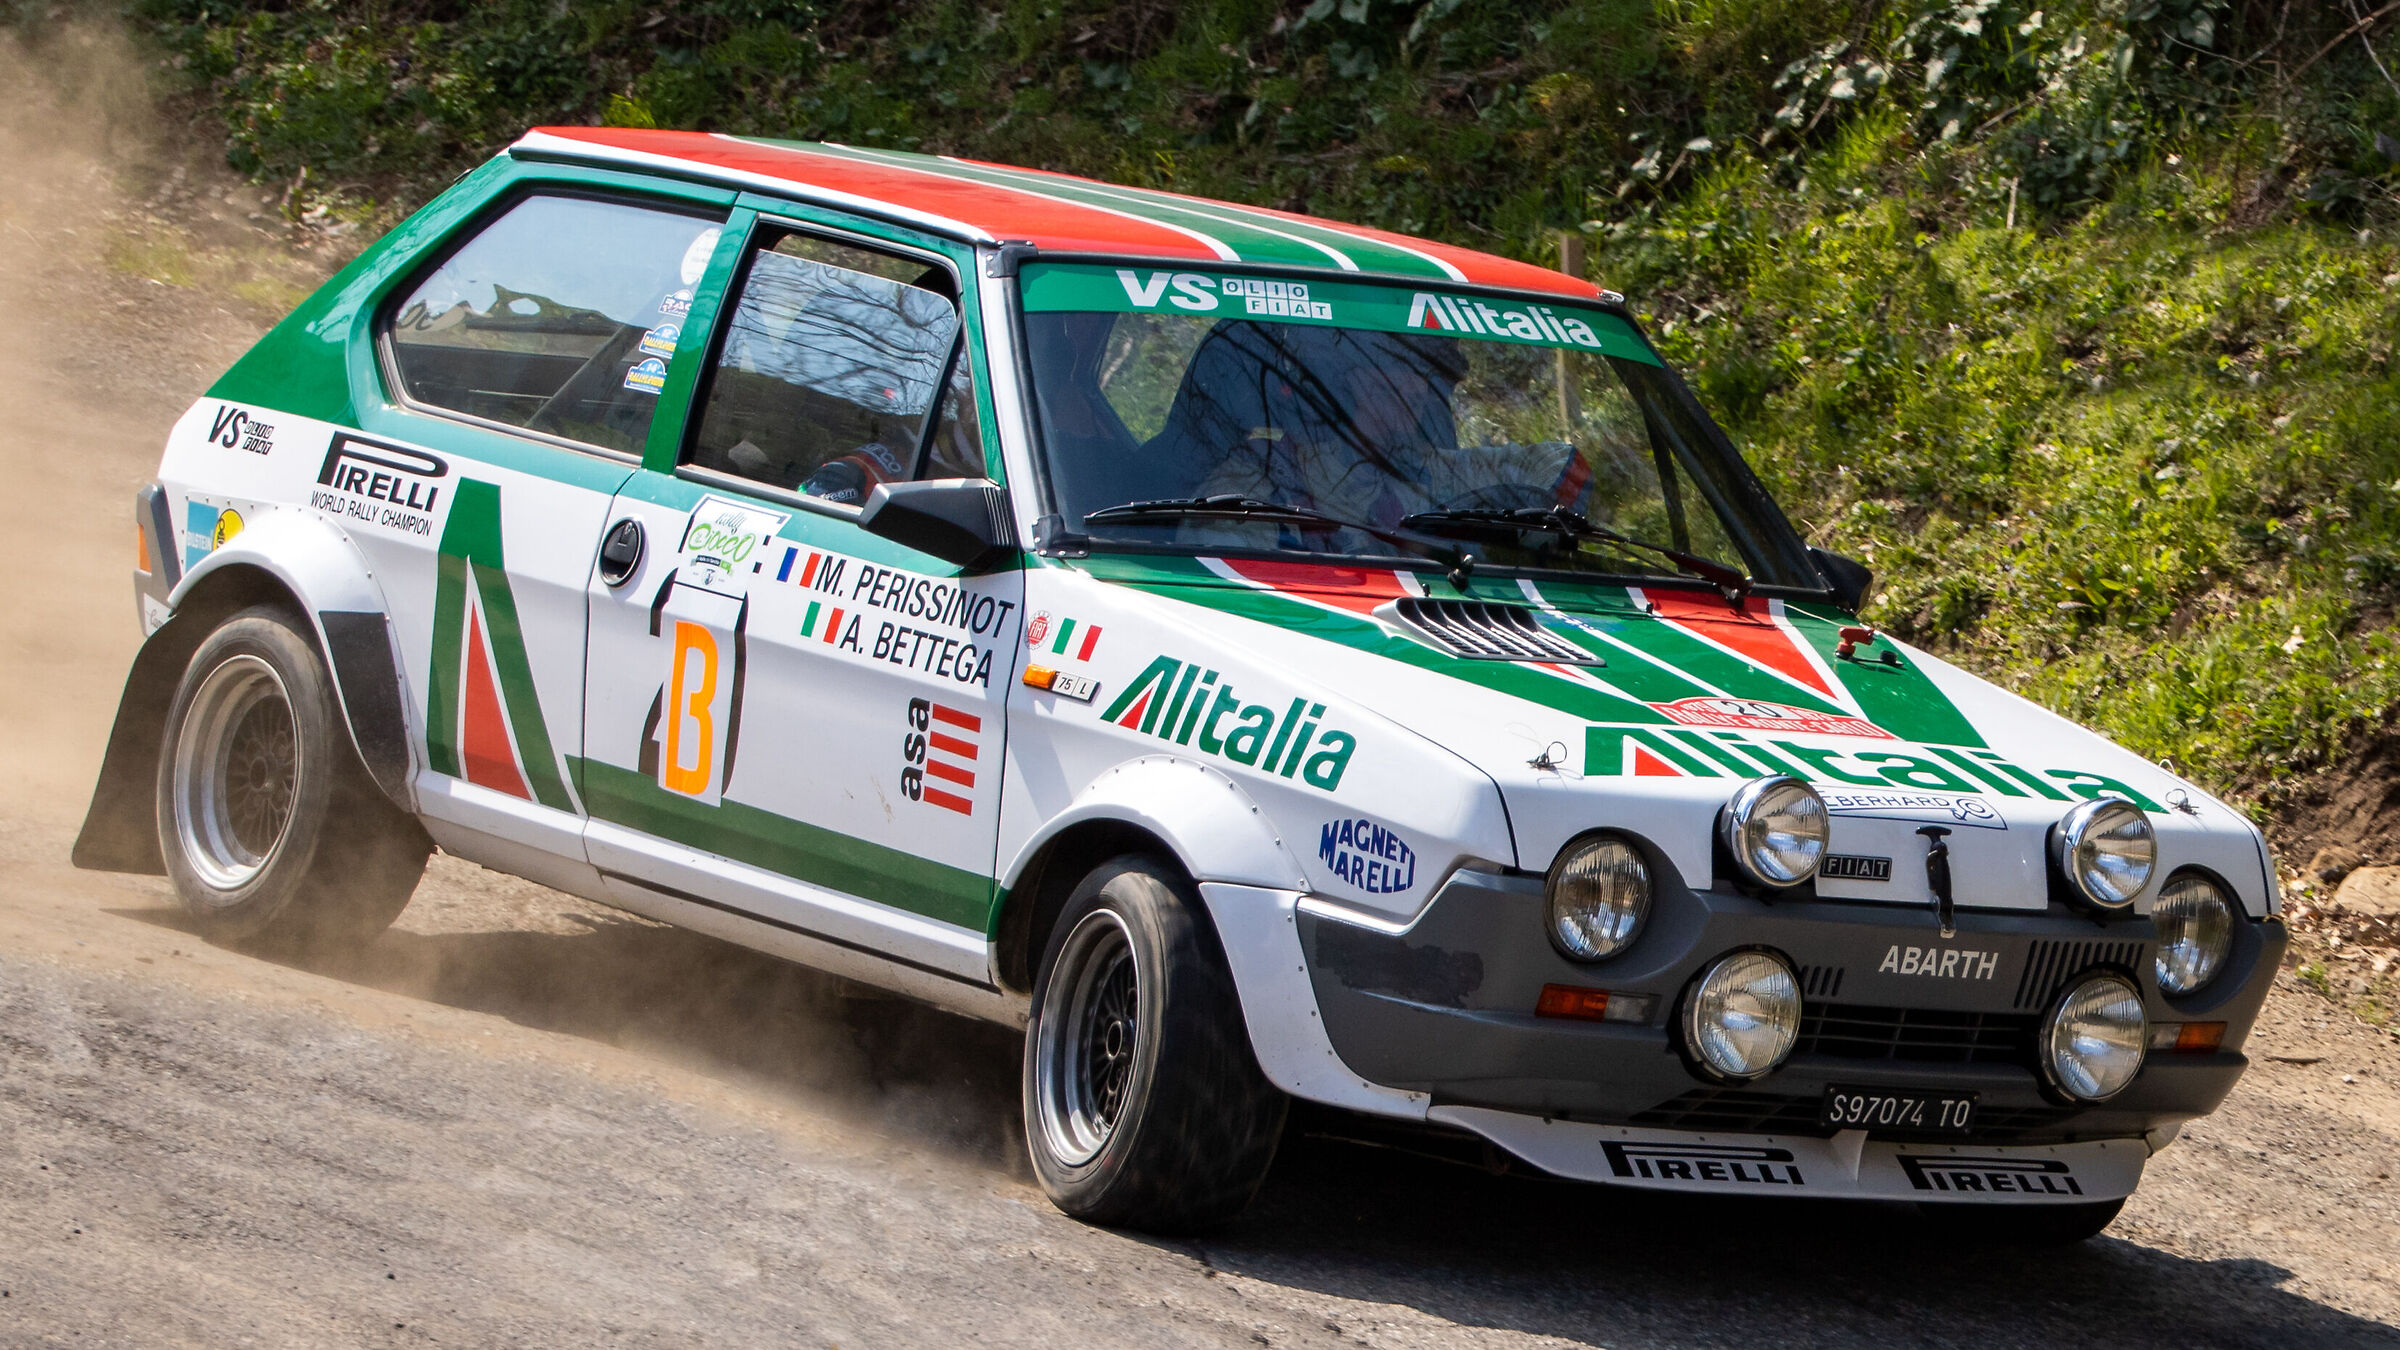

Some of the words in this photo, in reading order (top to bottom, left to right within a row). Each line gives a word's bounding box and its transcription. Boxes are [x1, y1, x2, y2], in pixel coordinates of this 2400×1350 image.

[1116, 270, 1218, 311] VS
[1222, 278, 1309, 298] OLIO
[1248, 298, 1331, 319] FIAT
[1407, 293, 1601, 348] Alitalia
[208, 405, 249, 449] VS
[243, 420, 274, 438] OLIO
[243, 437, 273, 455] FIAT
[317, 431, 449, 513] PIRELLI
[311, 490, 345, 514] WORLD
[347, 500, 379, 522] RALLY
[381, 509, 432, 536] CHAMPION
[815, 555, 846, 597] M.
[853, 565, 1015, 638] PERISSINOT
[839, 614, 863, 654] A.
[872, 621, 994, 688] BETTEGA
[665, 620, 718, 795] B
[1059, 677, 1072, 690] 75
[1079, 683, 1087, 695] L
[1101, 655, 1356, 791] Alitalia
[1662, 706, 1745, 725] RALLYE
[1721, 701, 1782, 717] 20
[901, 697, 930, 801] asa
[1585, 726, 2169, 814] Alitalia
[1319, 819, 1415, 866] MAGNETI
[1319, 848, 1415, 893] MARELLI
[1826, 857, 1889, 877] FIAT
[1879, 945, 1998, 979] ABARTH
[1830, 1094, 1925, 1126] S97074
[1601, 1139, 1805, 1185] PIRELLI
[1897, 1153, 2083, 1195] PIRELLI
